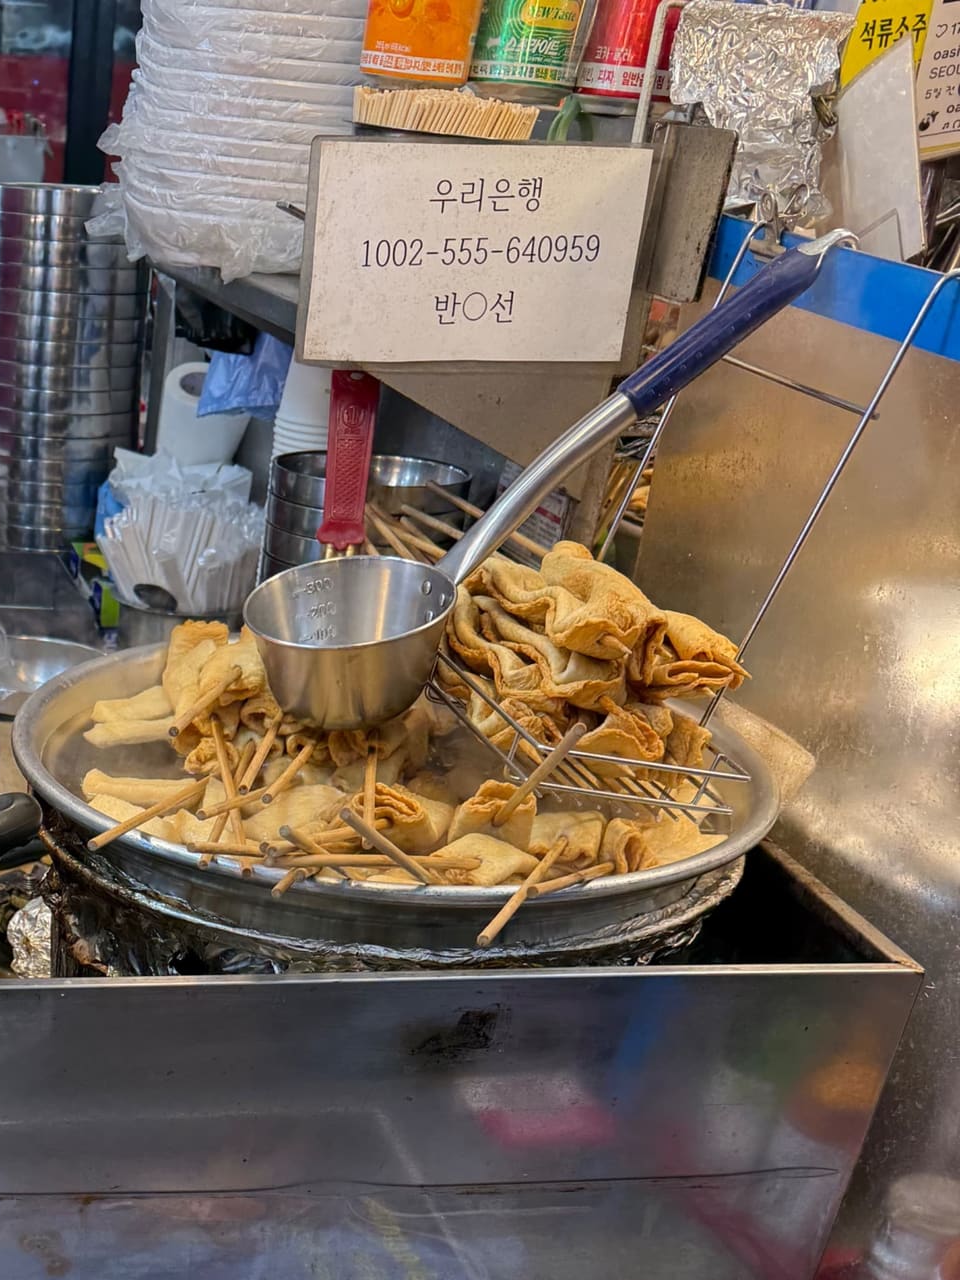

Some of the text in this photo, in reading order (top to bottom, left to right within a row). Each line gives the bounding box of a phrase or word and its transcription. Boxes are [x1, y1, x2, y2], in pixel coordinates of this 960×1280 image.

[860, 13, 927, 50] 석류소주
[429, 177, 543, 214] 우리은행
[361, 234, 600, 268] 1002-555-640959
